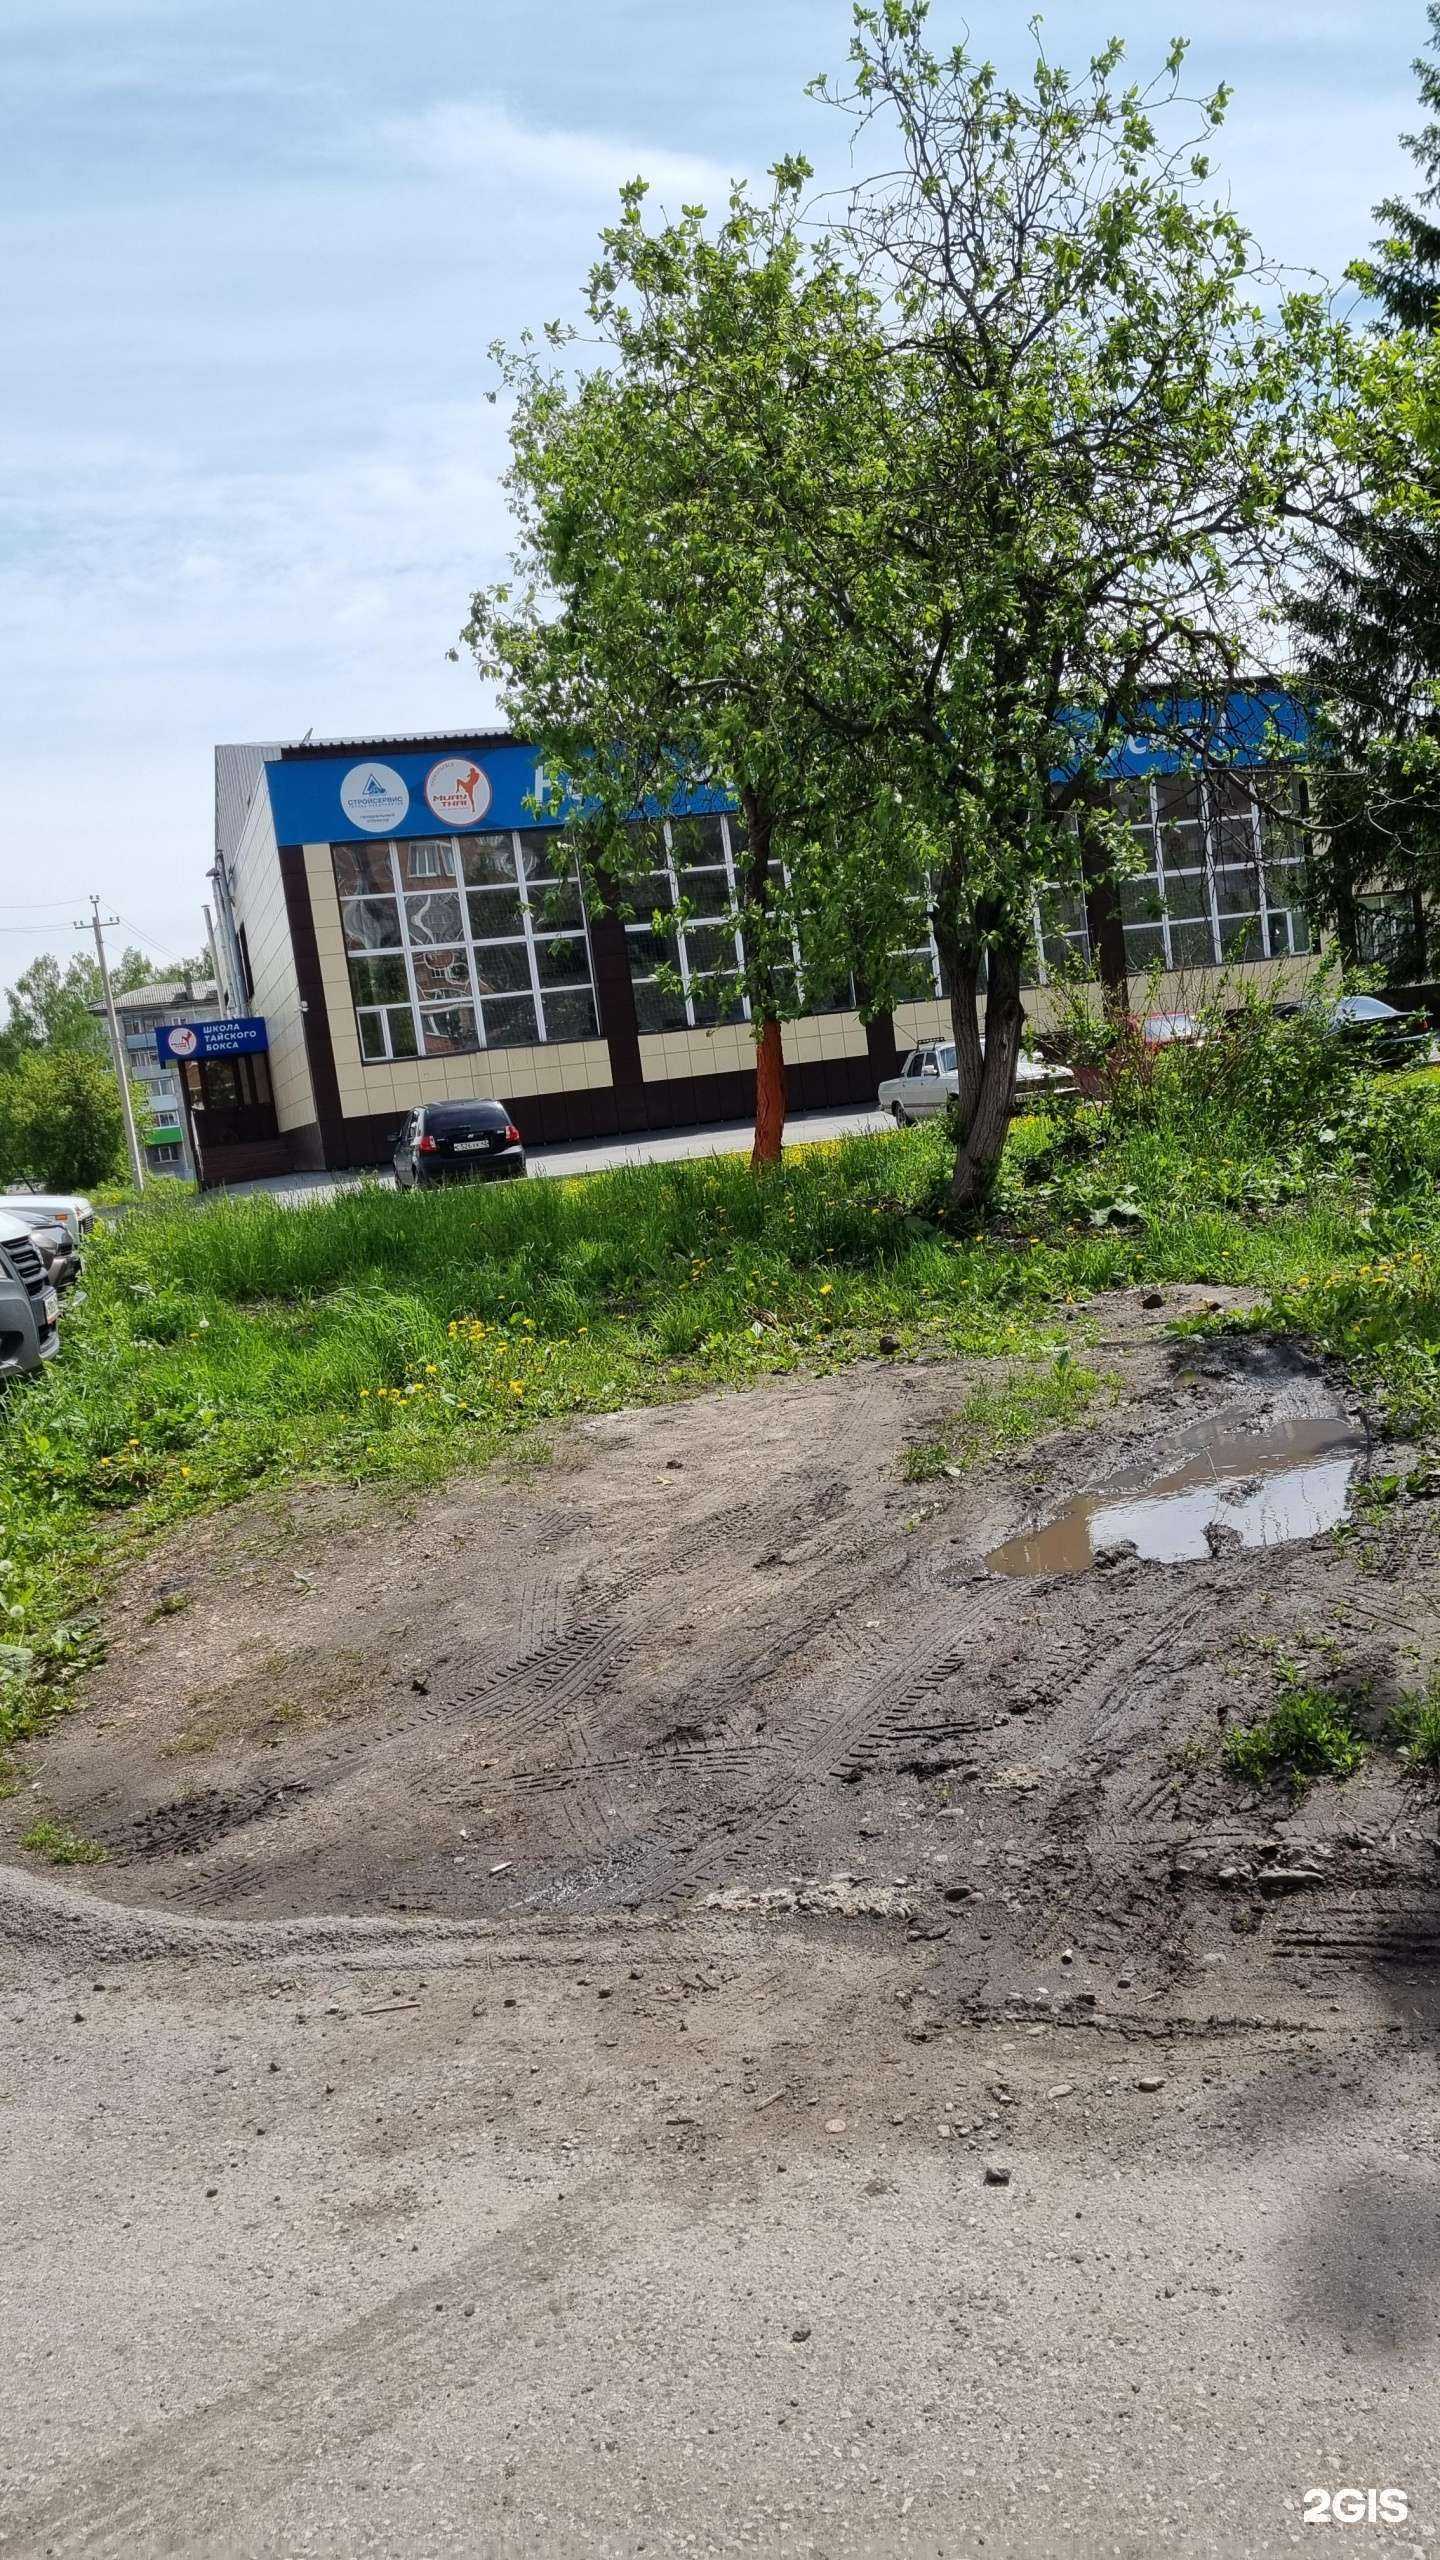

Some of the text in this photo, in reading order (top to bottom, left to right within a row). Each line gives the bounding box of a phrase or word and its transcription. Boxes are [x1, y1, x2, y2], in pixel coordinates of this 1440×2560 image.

[348, 796, 403, 806] СТРОЙСЕРВИС
[203, 1023, 240, 1034] ШКОЛА
[204, 1030, 257, 1043] ТАЙСКОГО
[206, 1041, 239, 1052] БОКСА
